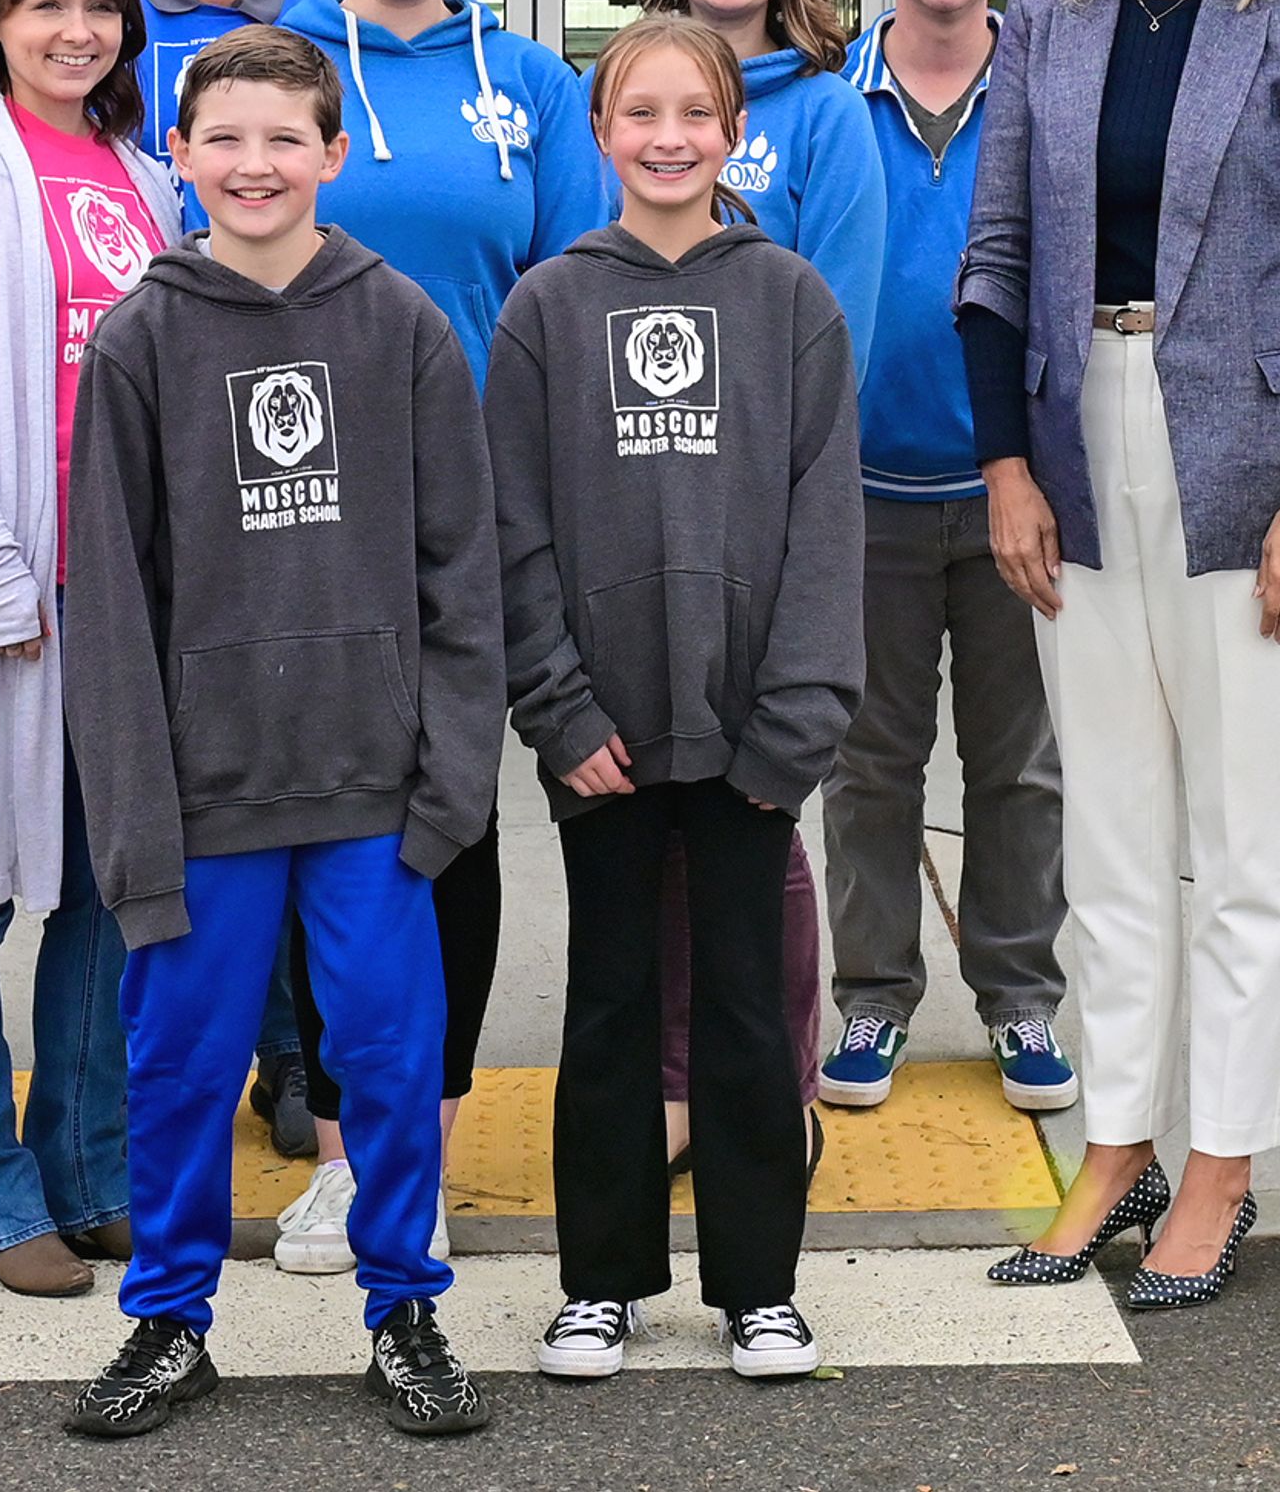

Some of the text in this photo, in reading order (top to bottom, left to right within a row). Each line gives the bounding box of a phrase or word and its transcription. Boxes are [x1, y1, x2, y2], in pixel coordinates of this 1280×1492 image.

[616, 410, 718, 438] MOSCOW
[617, 435, 718, 457] CHARTER SCHOOL
[240, 477, 339, 512] MOSCOW
[242, 505, 341, 532] CHARTER SCHOOL
